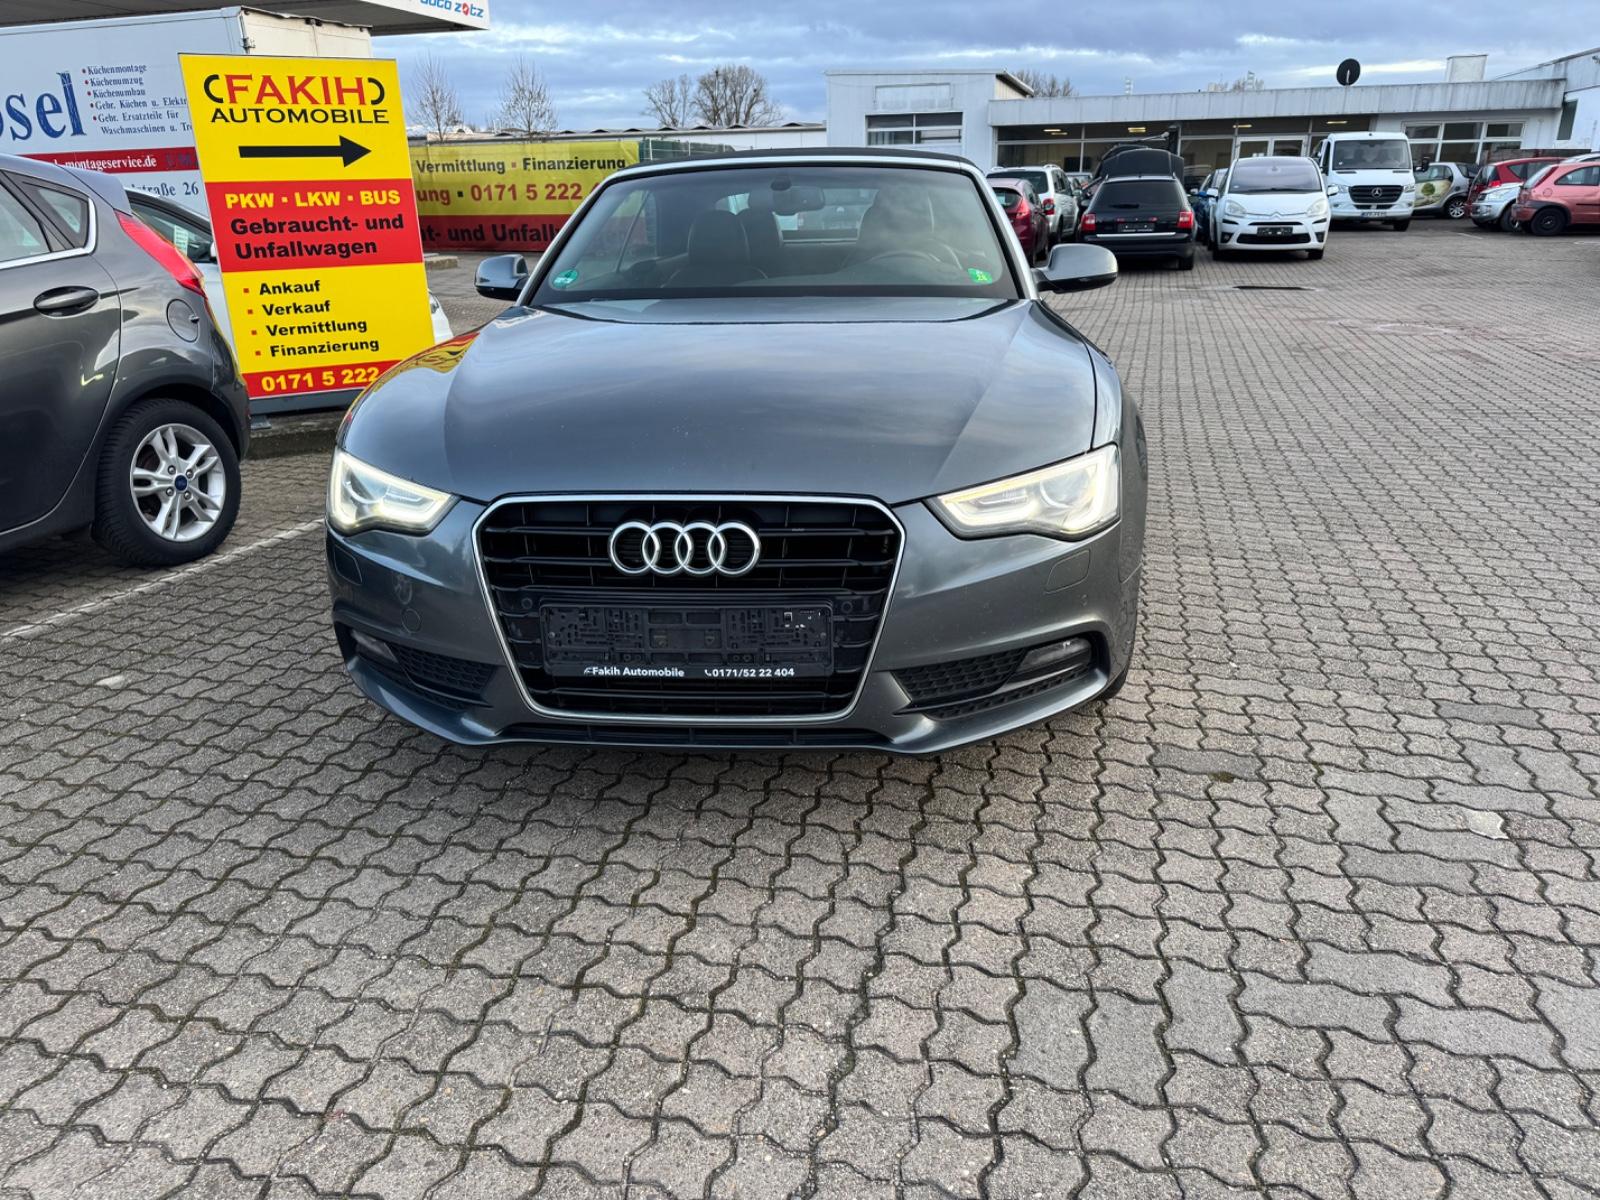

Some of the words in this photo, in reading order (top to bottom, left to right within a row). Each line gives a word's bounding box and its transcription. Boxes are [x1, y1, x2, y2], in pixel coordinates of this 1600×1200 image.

[88, 64, 147, 76] Küchenmontage
[90, 77, 144, 87] Küchenumzug
[224, 74, 367, 106] FAKIH
[92, 88, 146, 98] Küchenumbau
[0, 70, 87, 141] sel
[95, 101, 116, 110] Gebr.
[120, 100, 147, 109] Küchen
[98, 113, 118, 123] Gebr.
[122, 110, 162, 121] Ersatzteile
[166, 110, 179, 119] für
[211, 108, 389, 124] AUTOMOBILE
[100, 124, 166, 135] Waschmaschinen
[170, 124, 177, 132] u.
[416, 159, 506, 174] Vermittlung
[522, 157, 626, 171] Finanzierung
[182, 181, 200, 196] 26
[470, 184, 517, 201] 0171
[526, 184, 538, 200] 5
[544, 183, 582, 200] 222
[224, 193, 274, 209] PKW
[294, 191, 341, 207] LKW
[360, 190, 401, 206] BUS
[230, 216, 359, 235] Gebraucht-
[365, 214, 405, 230] und
[448, 224, 484, 242] und
[235, 240, 378, 260] Unfallwagen
[259, 280, 321, 296] Ankauf
[262, 300, 331, 316] Verkauf
[266, 320, 368, 337] Vermittlung
[270, 339, 380, 358] Finanzierung
[261, 372, 314, 392] 0171
[322, 371, 336, 386] 5
[341, 367, 380, 386] 222
[592, 666, 620, 676] Fakih
[622, 666, 686, 677] Automobile
[712, 668, 756, 678] 0171/52
[758, 669, 772, 678] 22
[774, 668, 795, 677] 404
